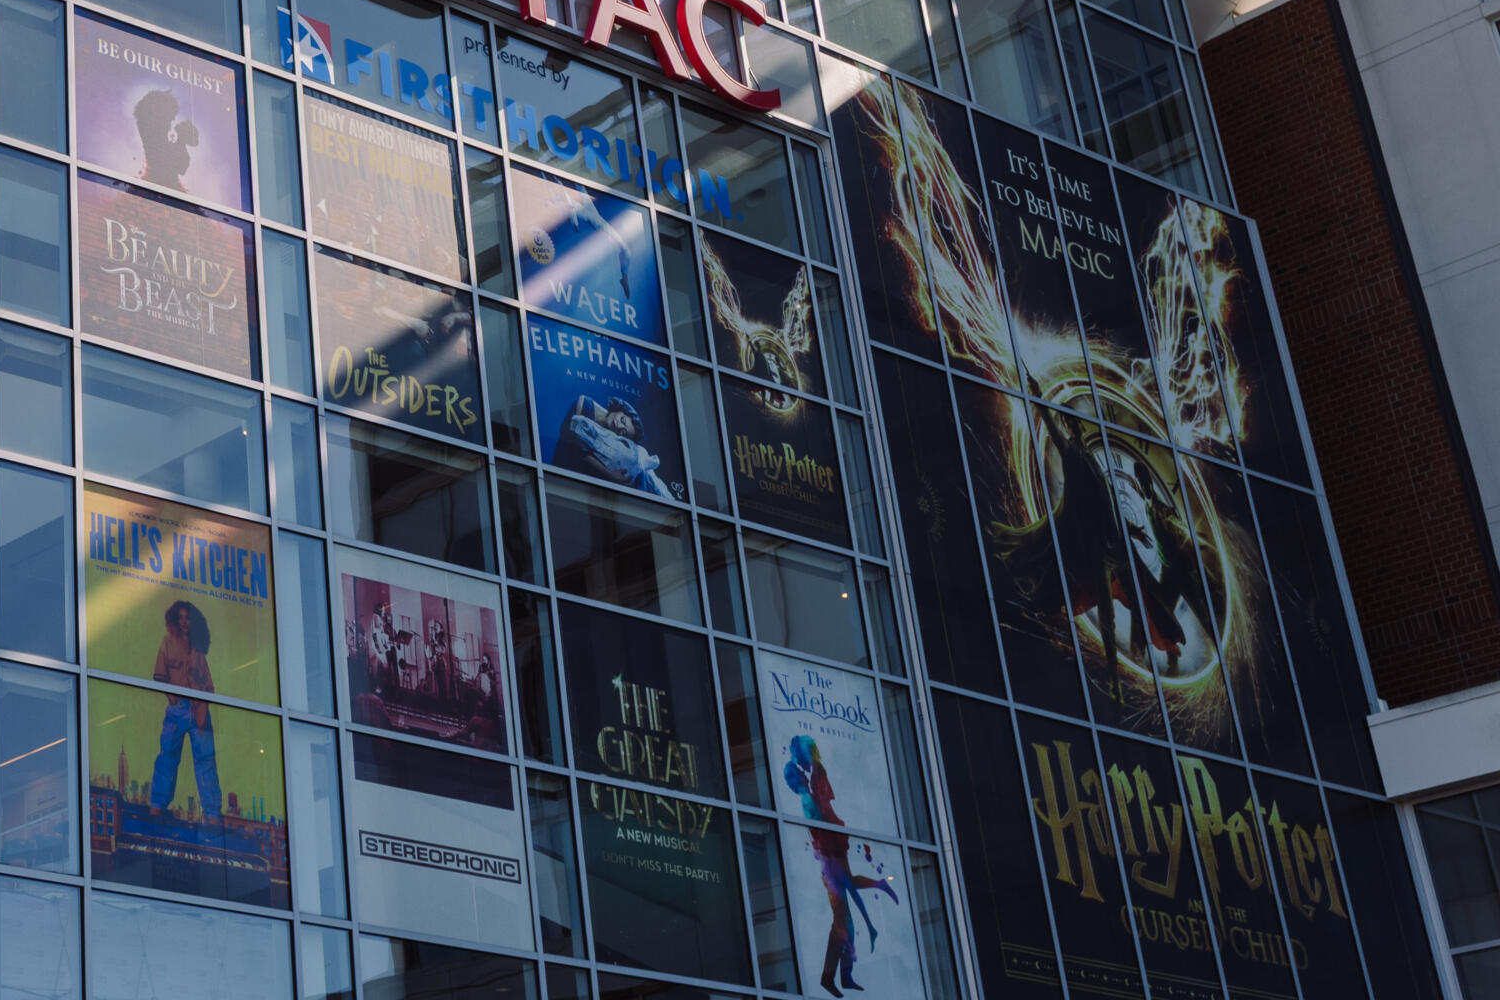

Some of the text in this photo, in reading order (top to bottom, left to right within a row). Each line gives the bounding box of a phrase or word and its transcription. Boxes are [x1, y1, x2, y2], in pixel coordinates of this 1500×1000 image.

[97, 37, 223, 95] BE OUR GUEST
[344, 37, 494, 133] FIRST
[464, 36, 570, 91] preented by
[309, 103, 453, 172] TONY AWARD WINNER
[310, 124, 361, 167] BEST
[1006, 148, 1093, 203] IT'S TIME
[990, 179, 1020, 207] TO
[1098, 221, 1122, 247] IN
[103, 217, 235, 297] BEAUTY
[1018, 216, 1115, 281] MAGIC
[100, 266, 238, 336] BEAST
[147, 308, 201, 330] THE MUSICAL
[549, 279, 638, 330] WATER
[365, 346, 389, 369] THE
[530, 327, 670, 391] ELEPHANTS
[566, 367, 642, 398] A NEW MUSICAL
[328, 345, 478, 435] OUTSIDERS
[733, 434, 835, 494] Harry Potter
[89, 511, 163, 574] HELL'S
[172, 531, 268, 600] KITCHEN
[96, 565, 264, 609] THE HIT BROADWAY MUSICAL FROM ALICIA KEYS
[612, 678, 671, 735] THE
[768, 670, 872, 726] Notebook
[803, 669, 833, 689] The
[596, 725, 700, 789] GREAT
[590, 781, 714, 840] GATSBY
[365, 836, 517, 879] STEREOPHONIC
[603, 850, 721, 884] DON'T MISS THE PARTY!
[616, 826, 703, 855] A NEW MUSICAL
[1032, 740, 1349, 940] Harry Potter
[1120, 904, 1309, 970] CURSED CHILD
[1187, 897, 1248, 923] AN THE
